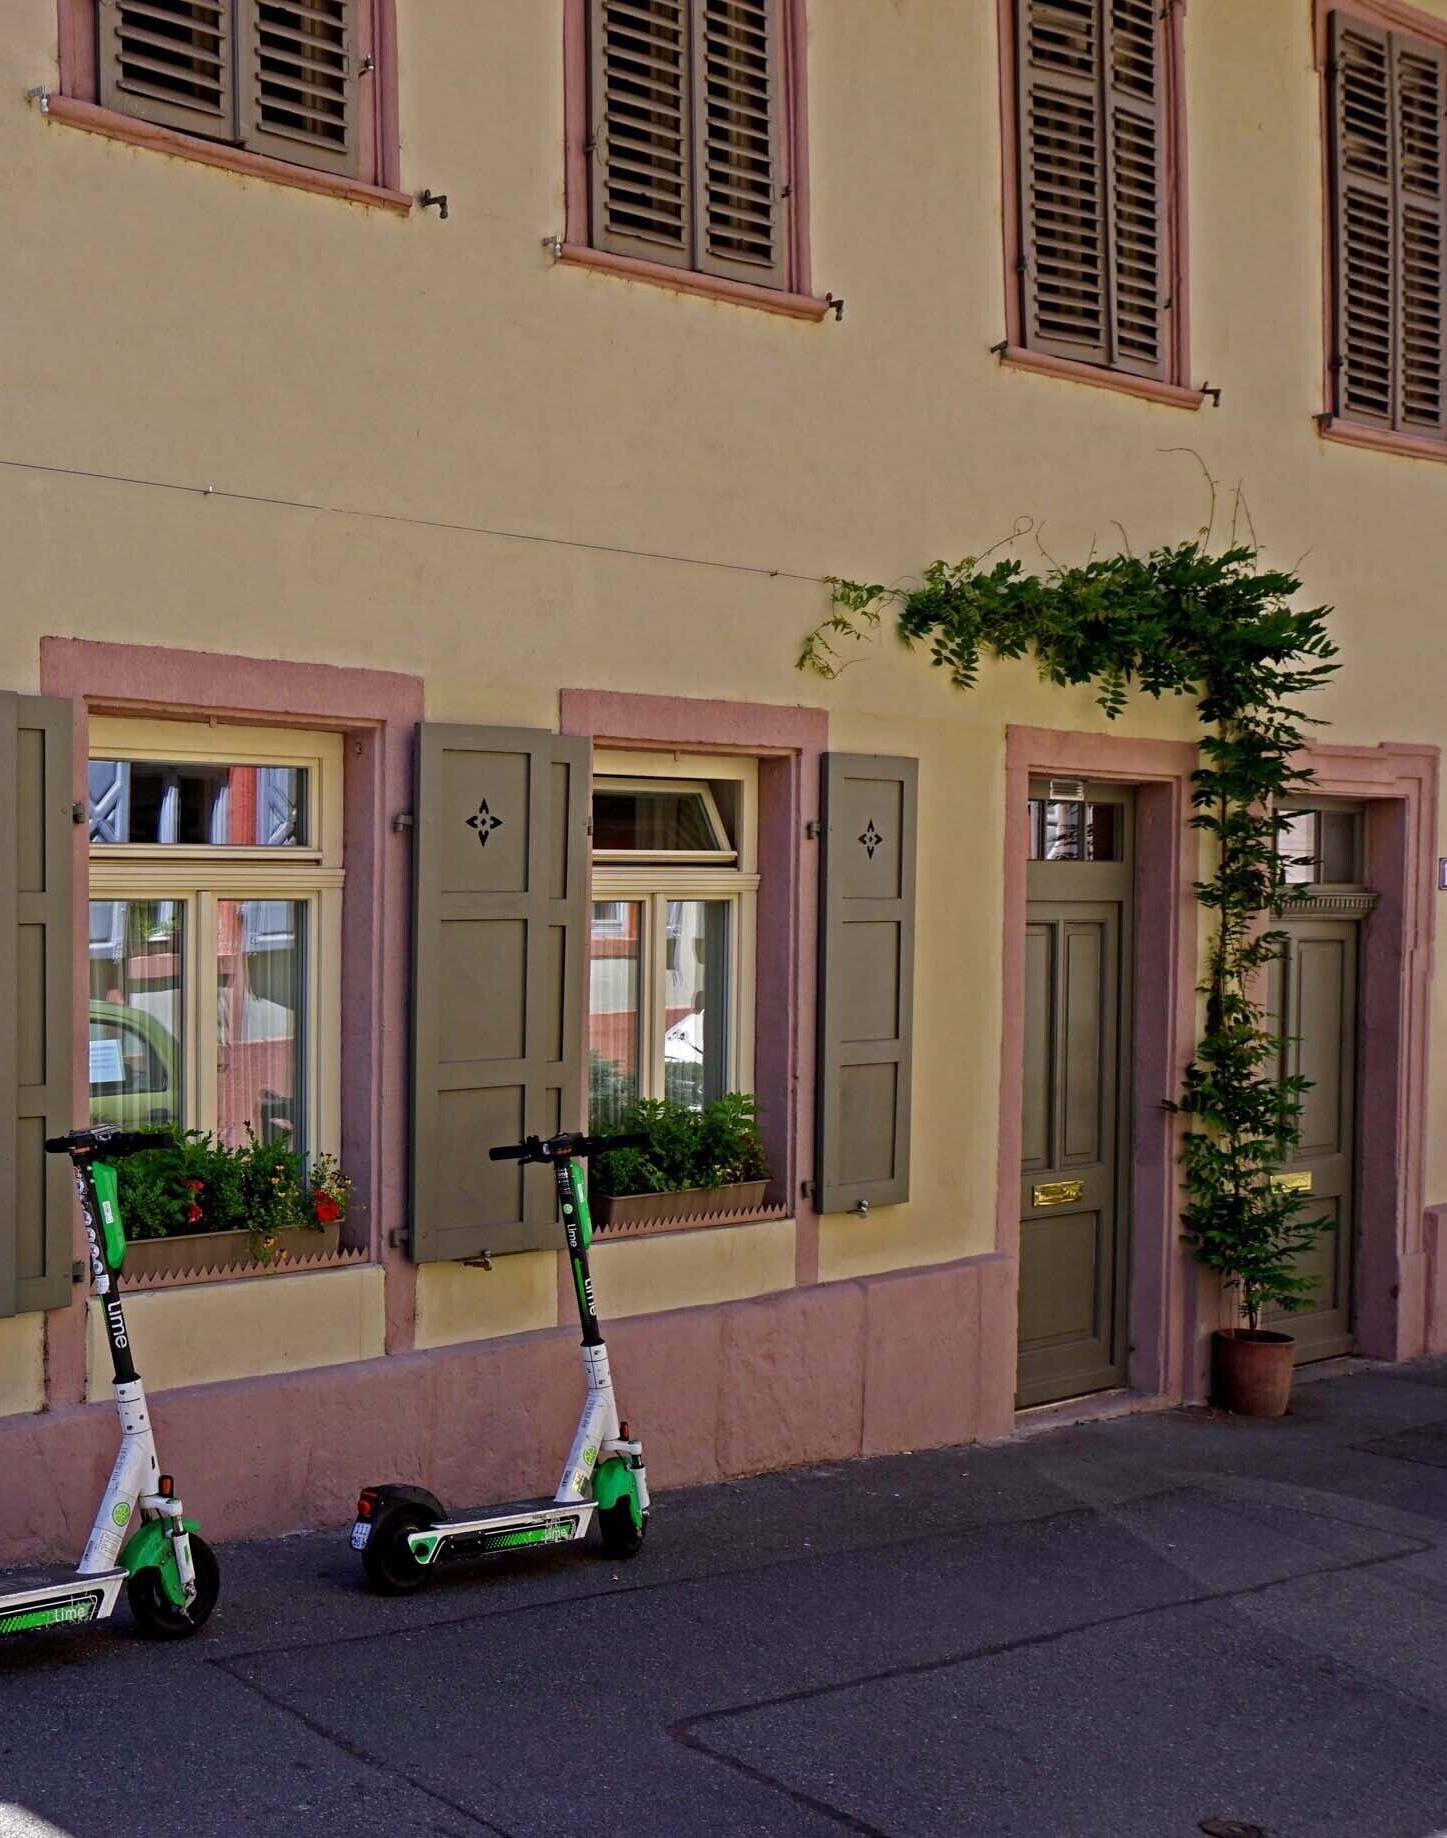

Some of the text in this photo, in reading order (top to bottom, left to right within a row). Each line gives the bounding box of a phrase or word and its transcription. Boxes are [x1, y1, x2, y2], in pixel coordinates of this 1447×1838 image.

[567, 1223, 578, 1248] Lime
[107, 1300, 128, 1349] Lime
[55, 1607, 85, 1622] Lime
